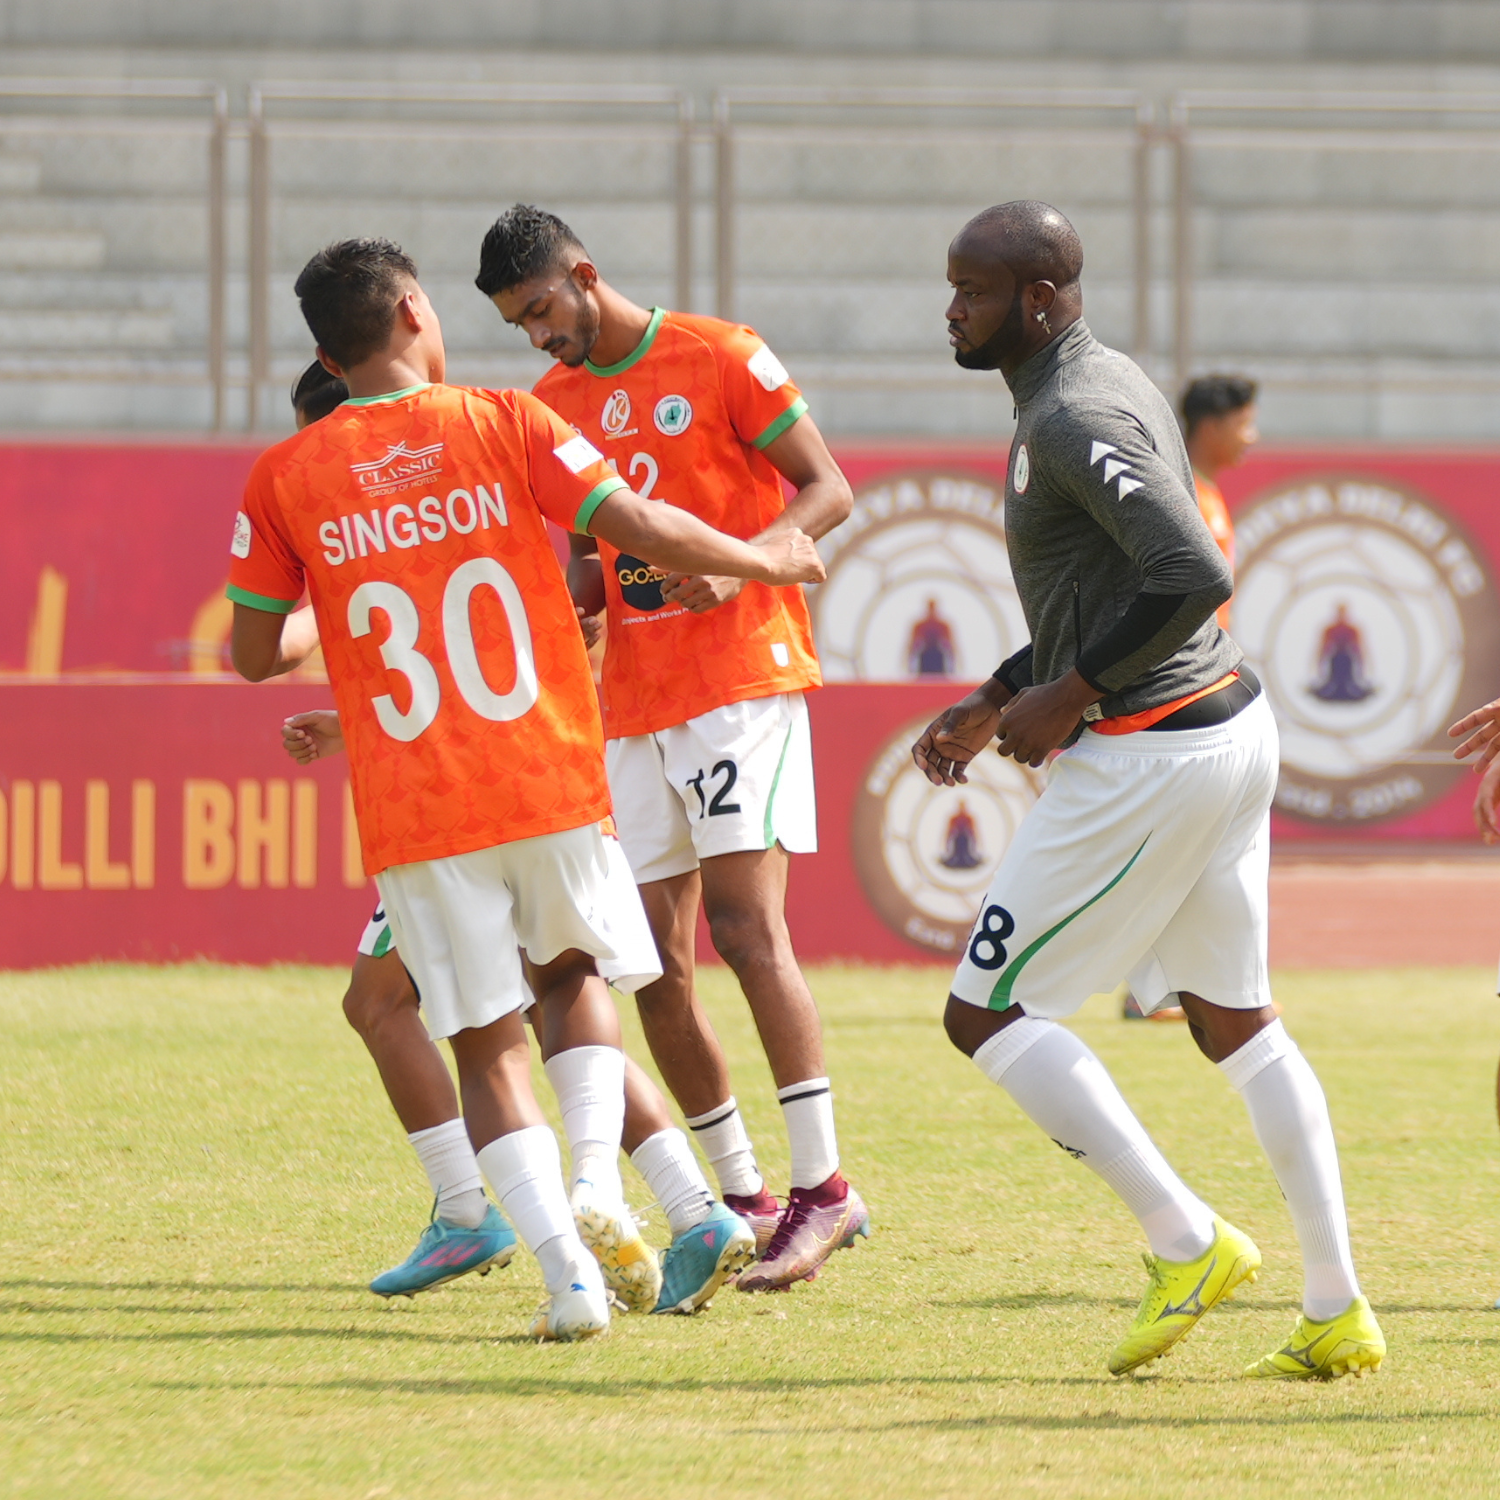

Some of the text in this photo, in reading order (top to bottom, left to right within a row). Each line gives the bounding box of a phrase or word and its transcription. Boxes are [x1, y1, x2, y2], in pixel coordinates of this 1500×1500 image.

[358, 454, 441, 485] CLASSIC
[368, 475, 438, 498] GROUP OF HOTELS
[318, 482, 509, 566] SINGSON
[347, 556, 539, 742] 30
[182, 777, 319, 891] BHI
